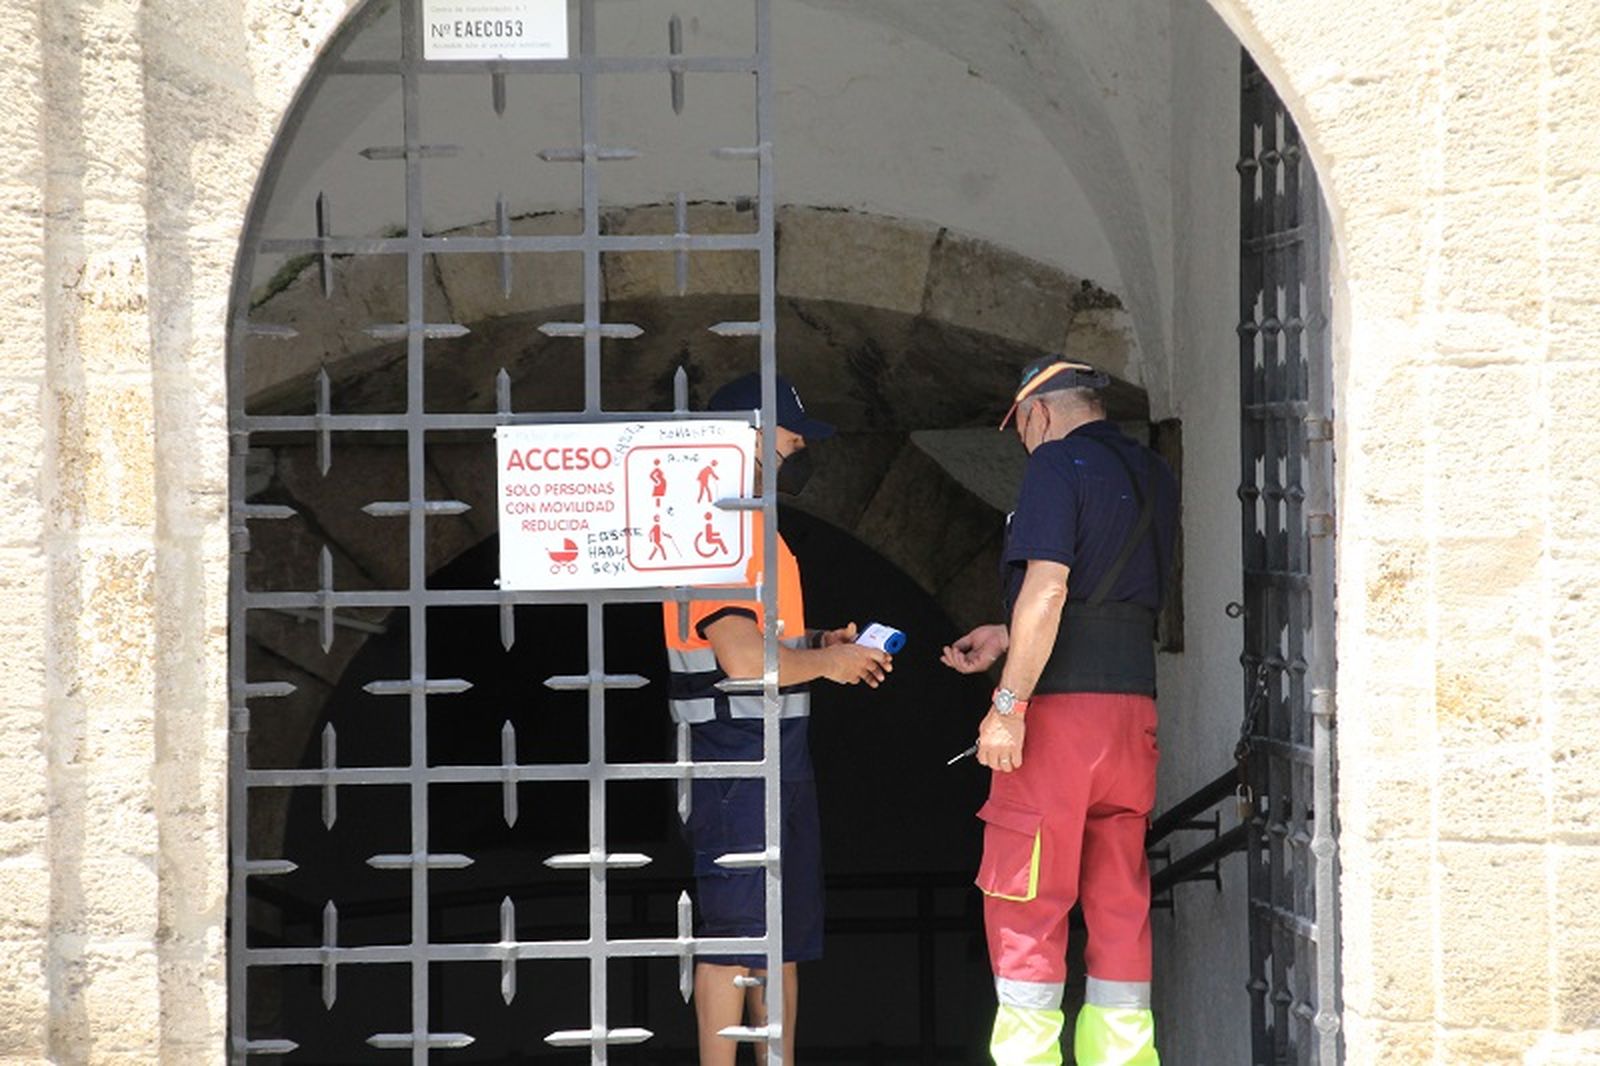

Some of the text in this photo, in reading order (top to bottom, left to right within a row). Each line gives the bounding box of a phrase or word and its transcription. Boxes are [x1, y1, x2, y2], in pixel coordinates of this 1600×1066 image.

[454, 20, 524, 38] EAEC053
[506, 447, 612, 471] ACCESO
[505, 481, 615, 497] SOLO PERSONAS
[505, 499, 615, 515] CON MOVILIDAD
[521, 519, 590, 532] REDUCIDA
